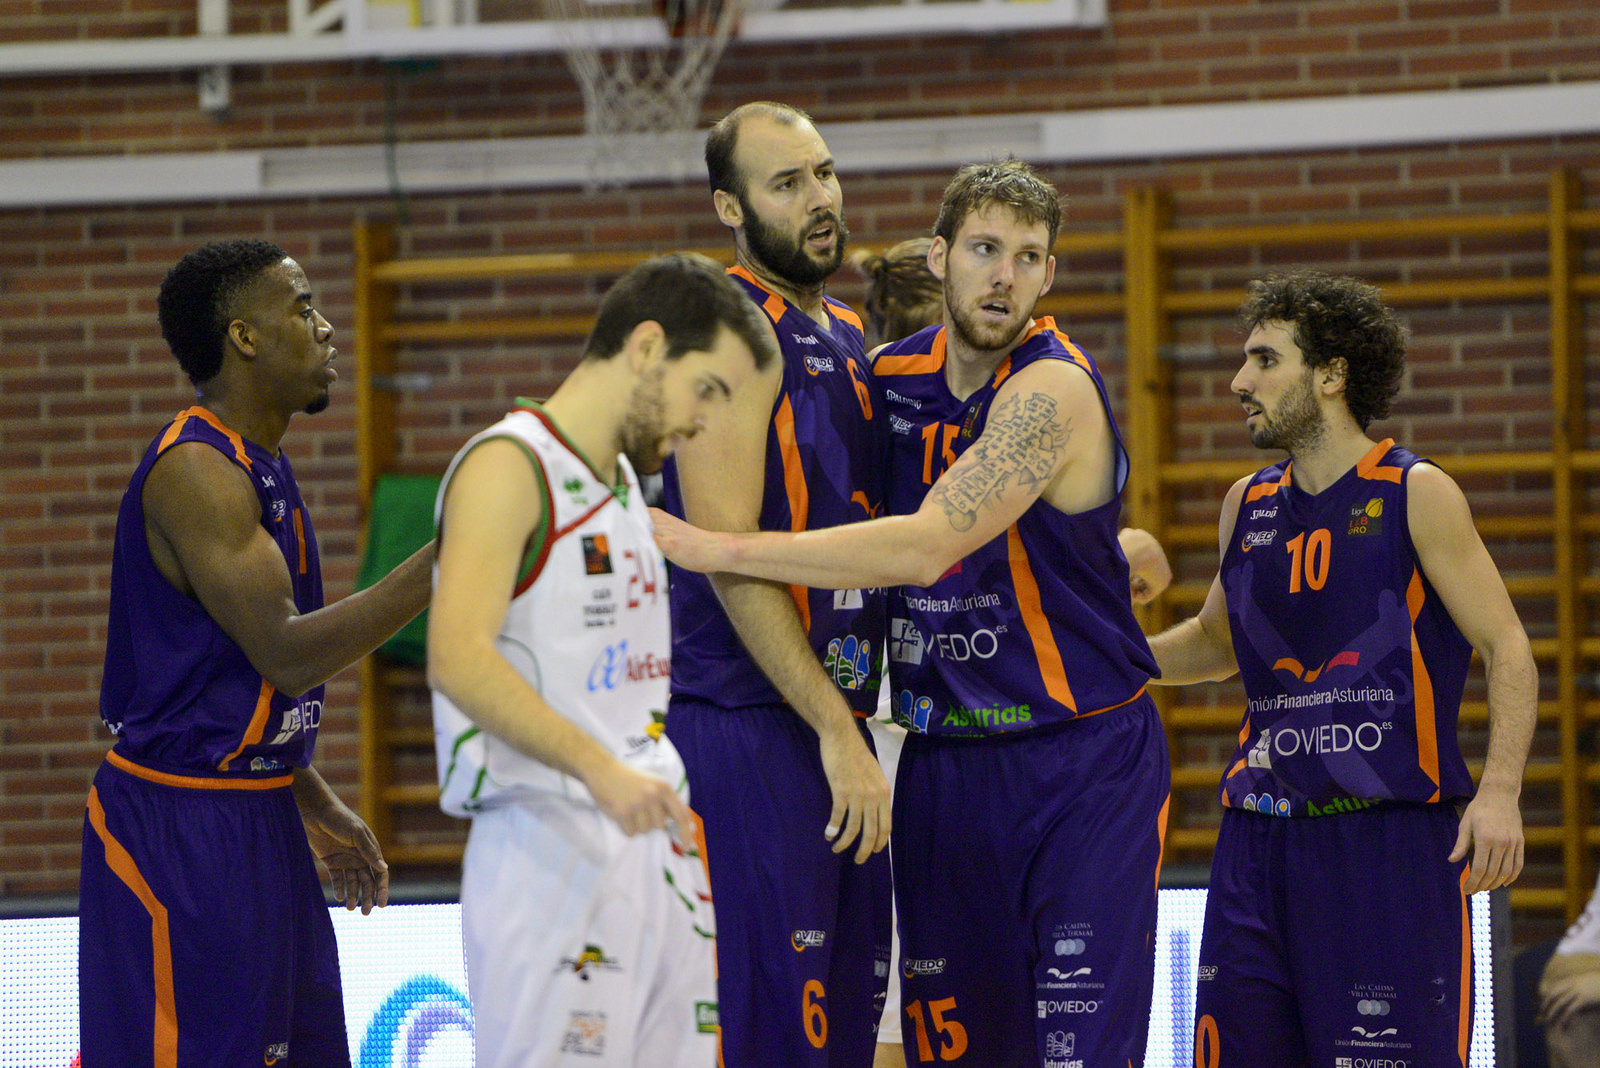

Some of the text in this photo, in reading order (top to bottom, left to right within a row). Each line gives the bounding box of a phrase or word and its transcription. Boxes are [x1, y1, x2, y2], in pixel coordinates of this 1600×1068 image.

[847, 358, 873, 420] 6
[623, 547, 658, 609] 24
[1286, 528, 1332, 594] 10
[803, 979, 828, 1048] 6
[905, 996, 968, 1062] 15
[1047, 1000, 1098, 1013] OVIEDO
